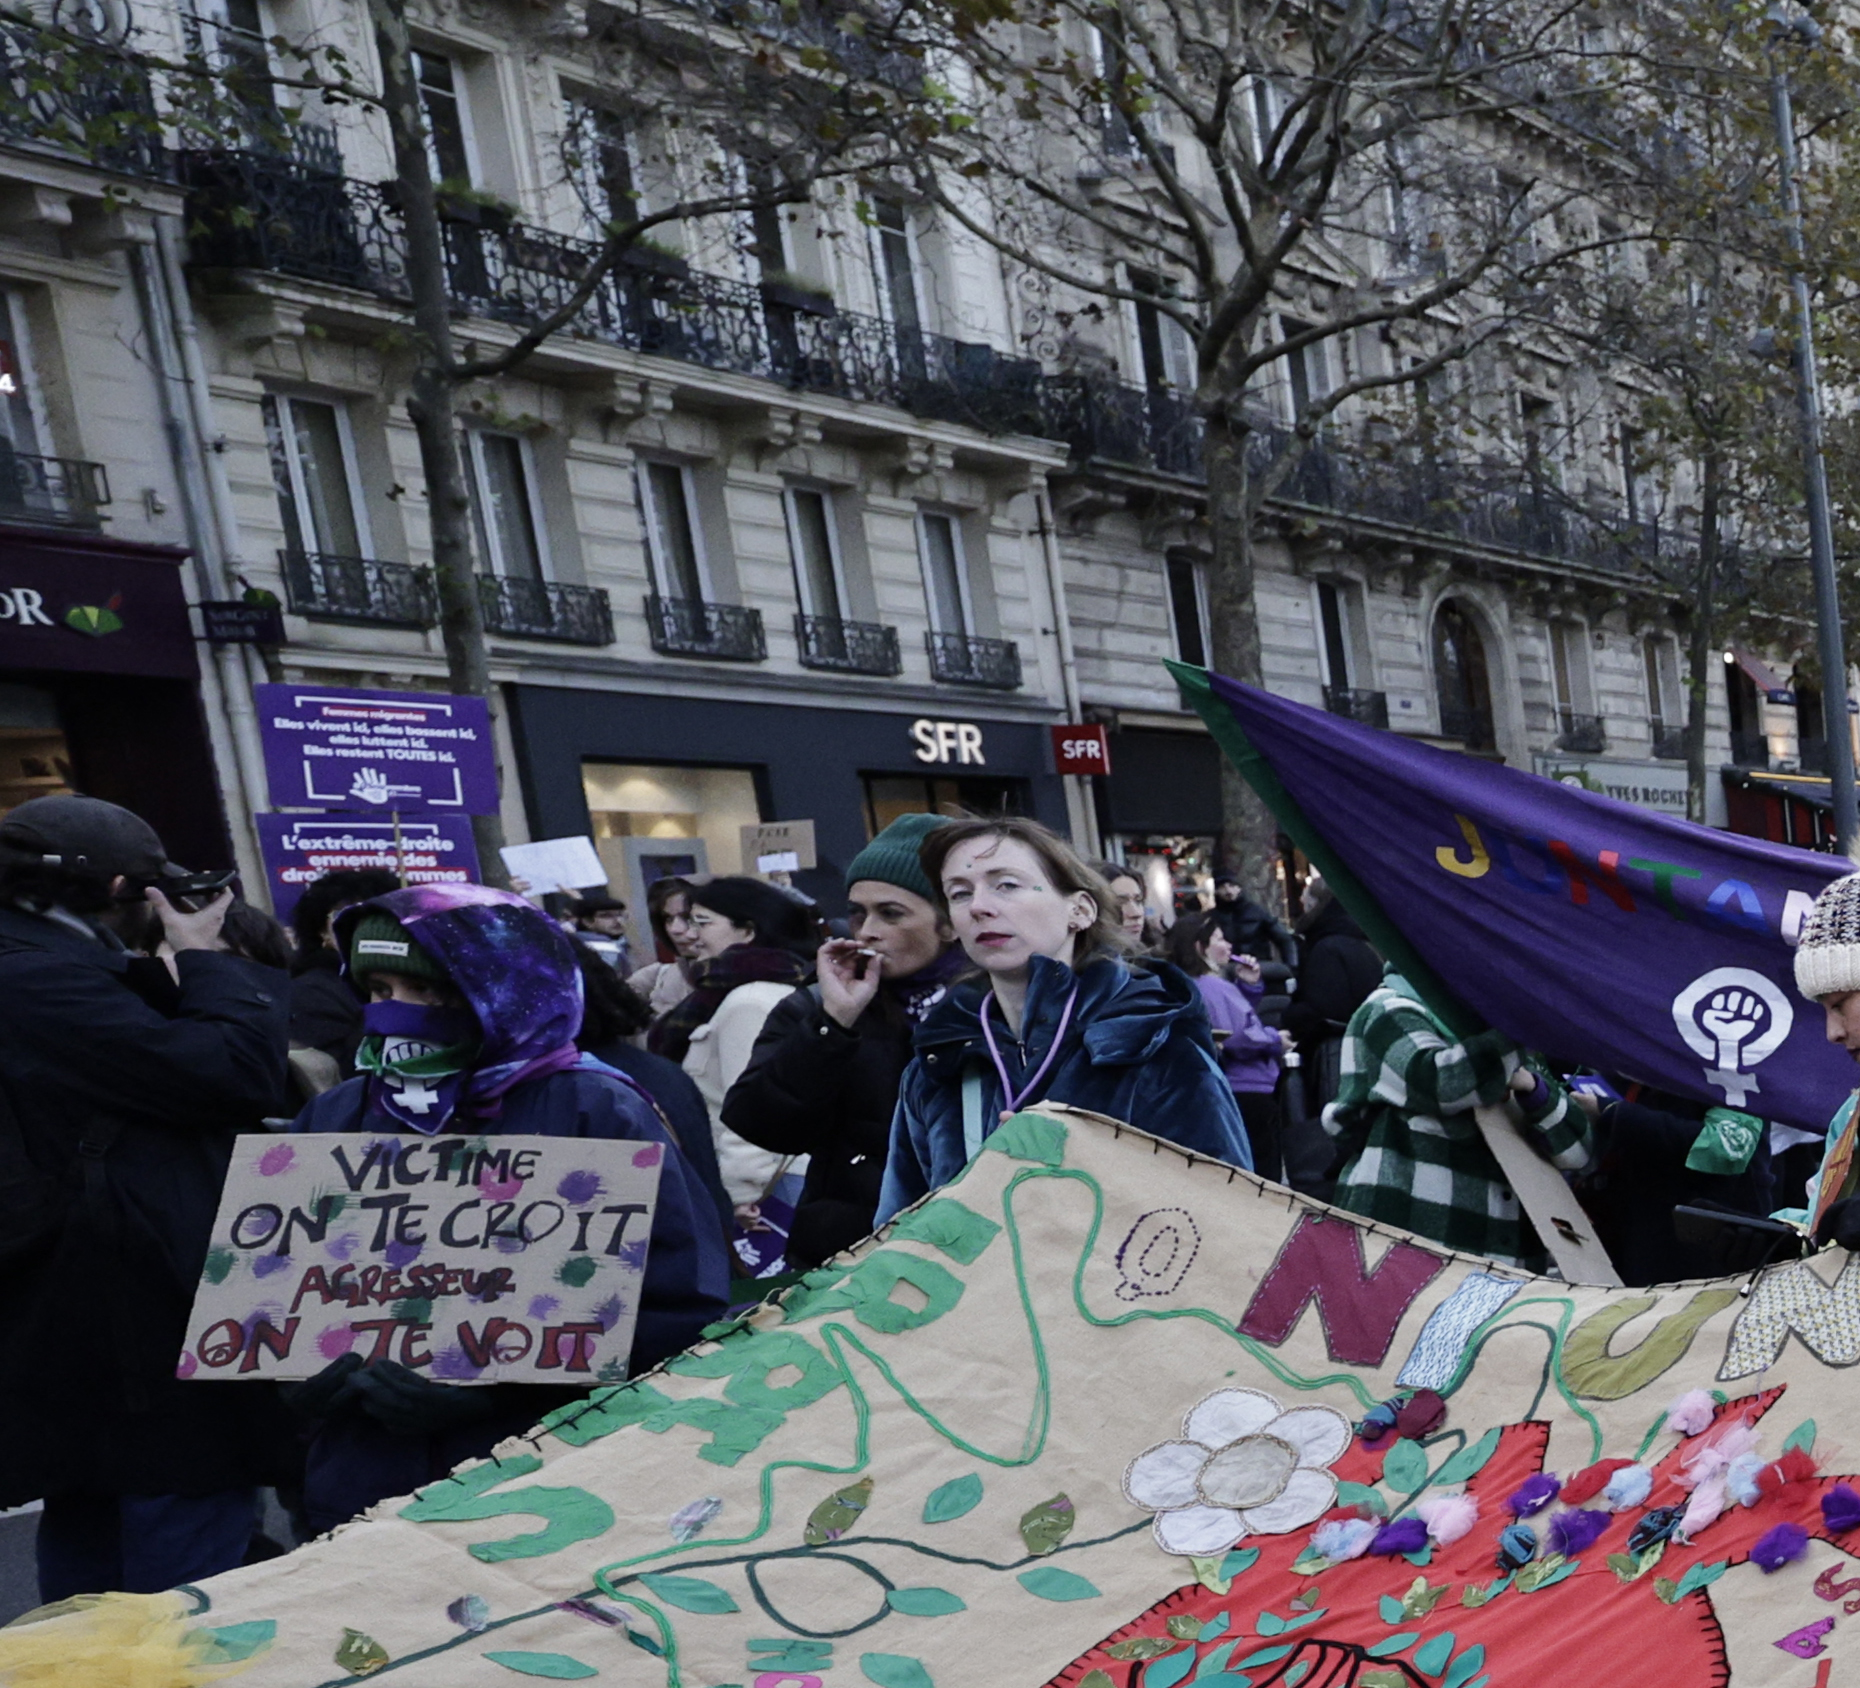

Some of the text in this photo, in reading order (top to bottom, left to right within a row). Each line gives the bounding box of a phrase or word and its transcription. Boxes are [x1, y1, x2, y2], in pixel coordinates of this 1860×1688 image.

[274, 718, 304, 730] Elles
[307, 720, 351, 732] vivent
[373, 723, 403, 735] elles
[405, 726, 457, 738] bossent
[329, 735, 360, 746] elles
[362, 735, 408, 748] luttent
[909, 718, 986, 766] SFR
[1062, 739, 1103, 760] SFR
[303, 744, 333, 756] Elles
[336, 747, 384, 759] restent
[386, 749, 436, 762] TOUTES
[309, 852, 437, 867] ennemie des
[330, 1138, 542, 1192] VICTIME
[231, 1195, 648, 1256] ON TE CROIT
[289, 1262, 517, 1314] AGRESSEUR
[1235, 1208, 1525, 1390] NI
[197, 1317, 605, 1373] ON TE VOIT
